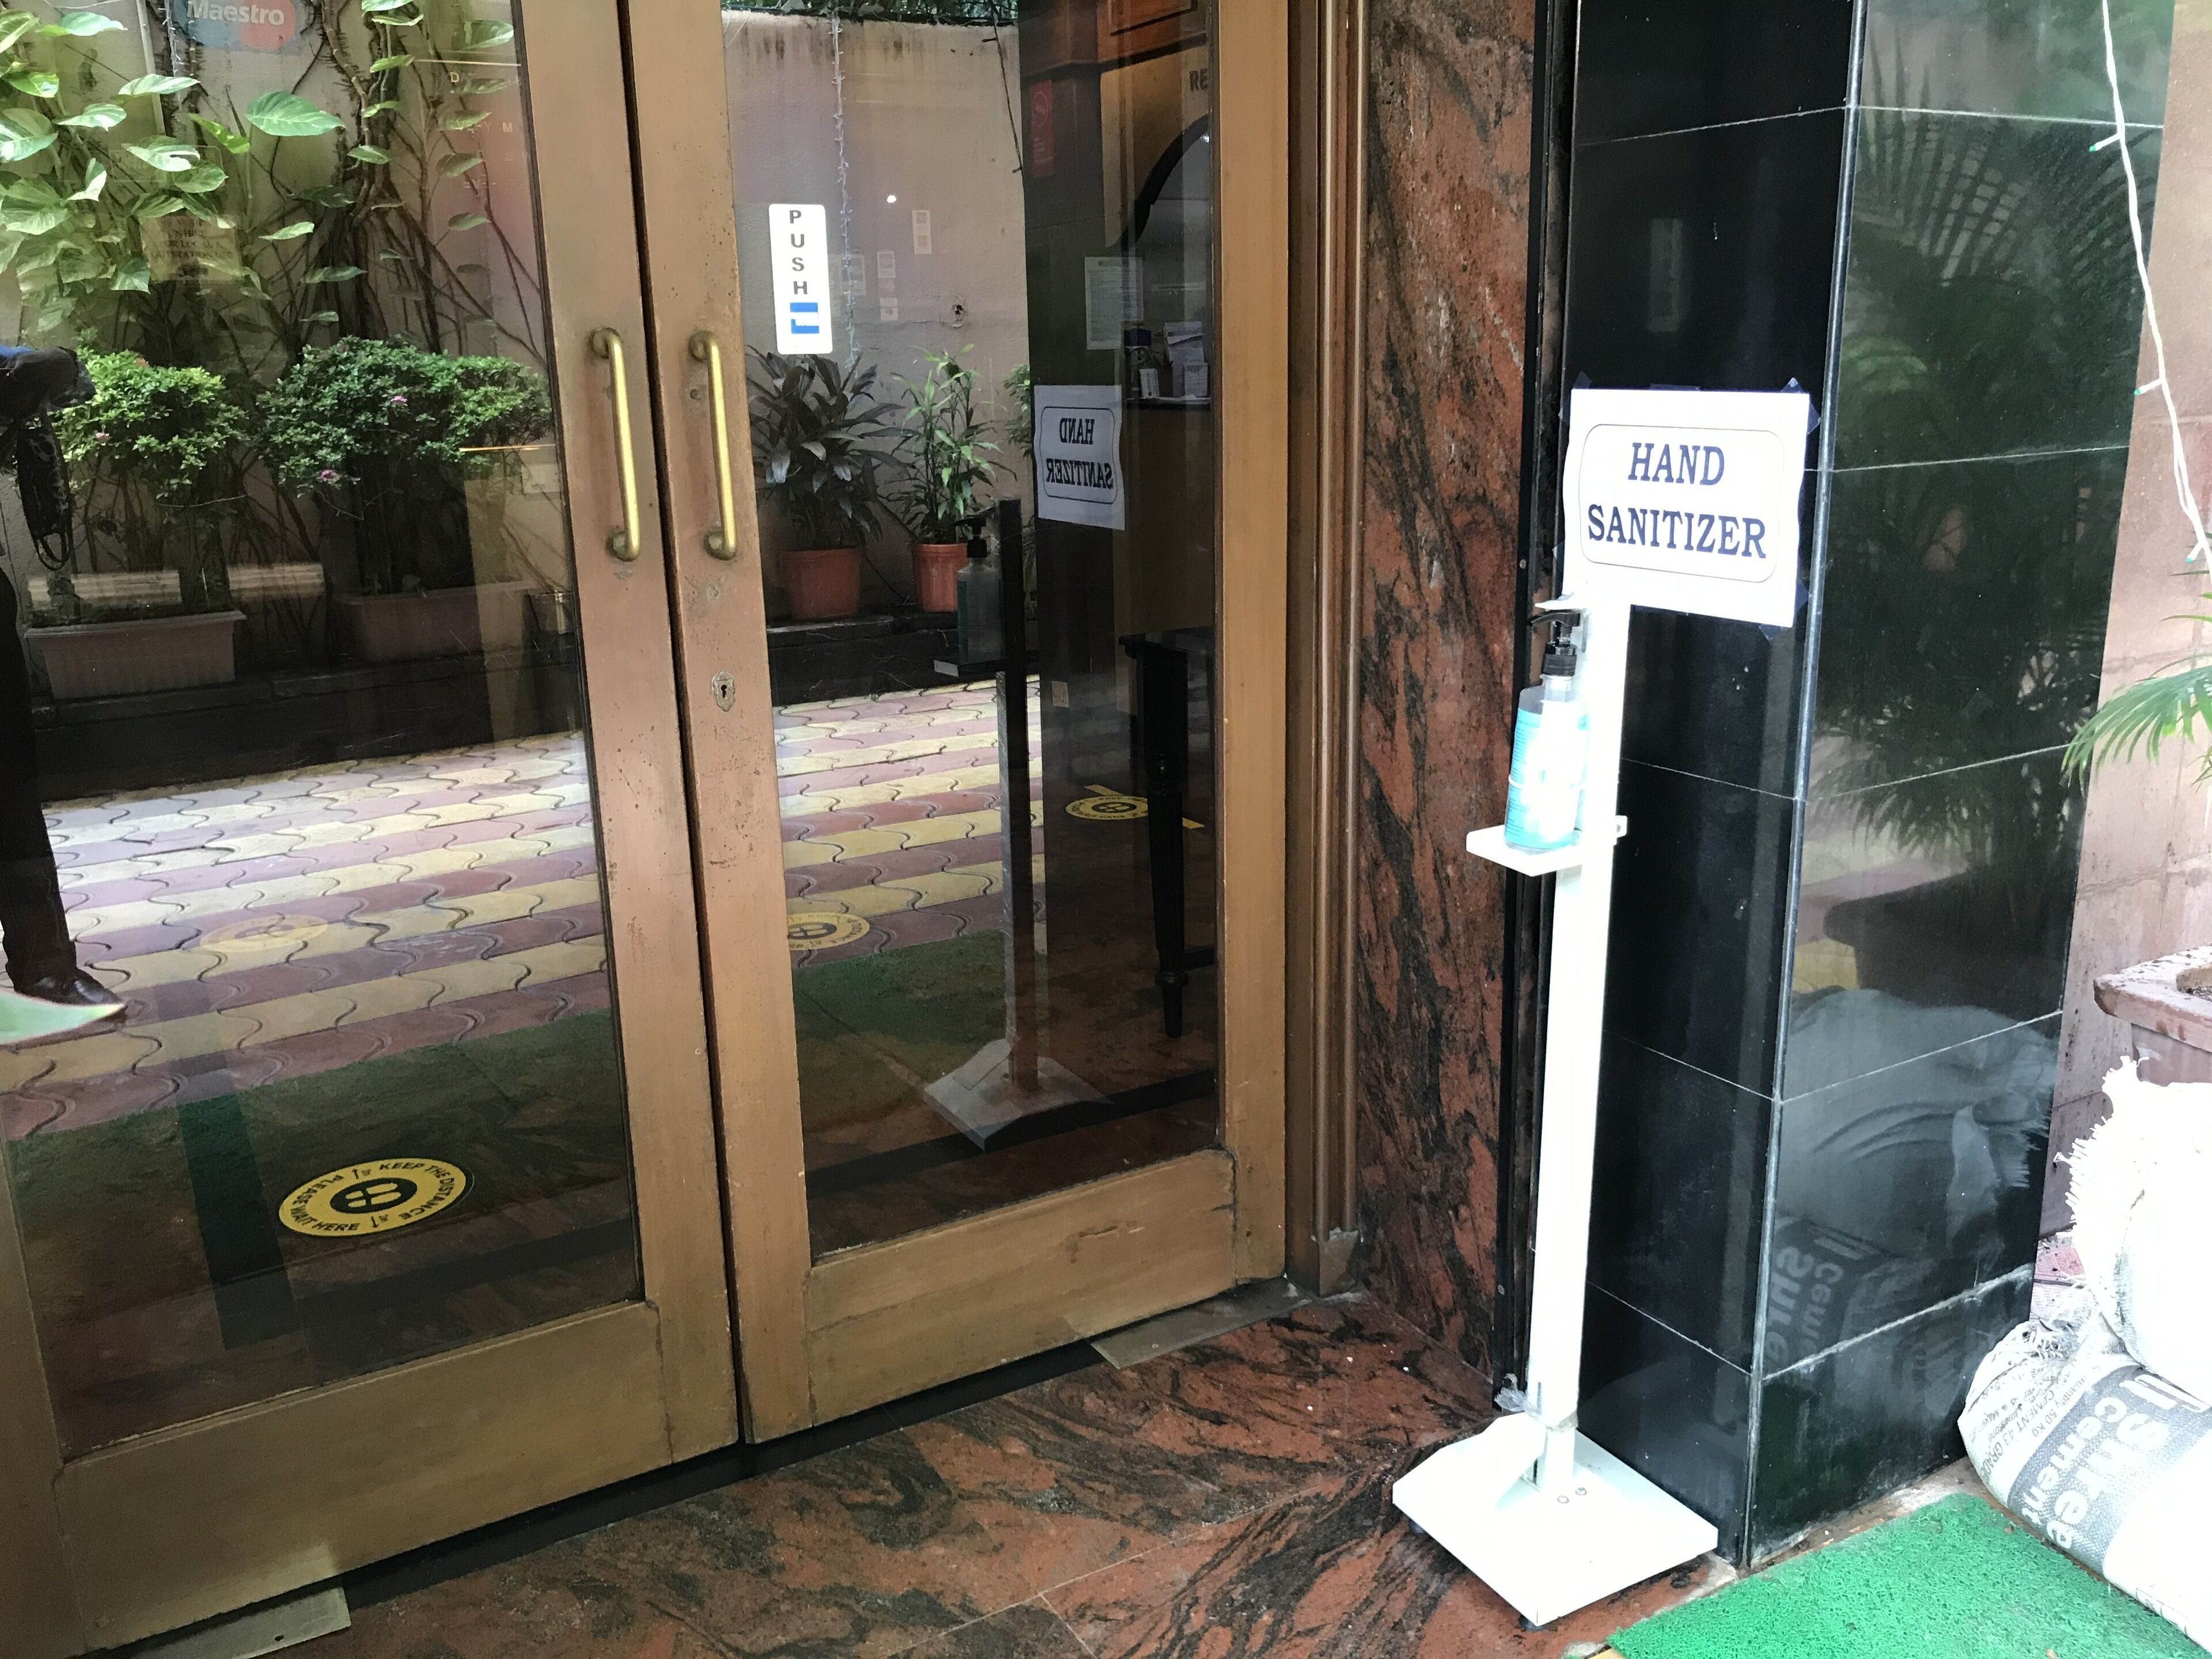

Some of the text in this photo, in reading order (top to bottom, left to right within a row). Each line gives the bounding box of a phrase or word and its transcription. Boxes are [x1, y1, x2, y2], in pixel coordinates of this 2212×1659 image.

[187, 0, 285, 25] Maestro
[789, 210, 808, 295] PUSH
[1628, 442, 1725, 486] HAND
[1588, 504, 1766, 559] SANITIZER
[290, 1175, 361, 1232] PLEASE WAIT HERE
[379, 1162, 455, 1220] KEEP THE DISTANCE
[2018, 1390, 2055, 1433] CEMENT
[2021, 1397, 2127, 1525] Cement
[2047, 1413, 2169, 1549] Shree
